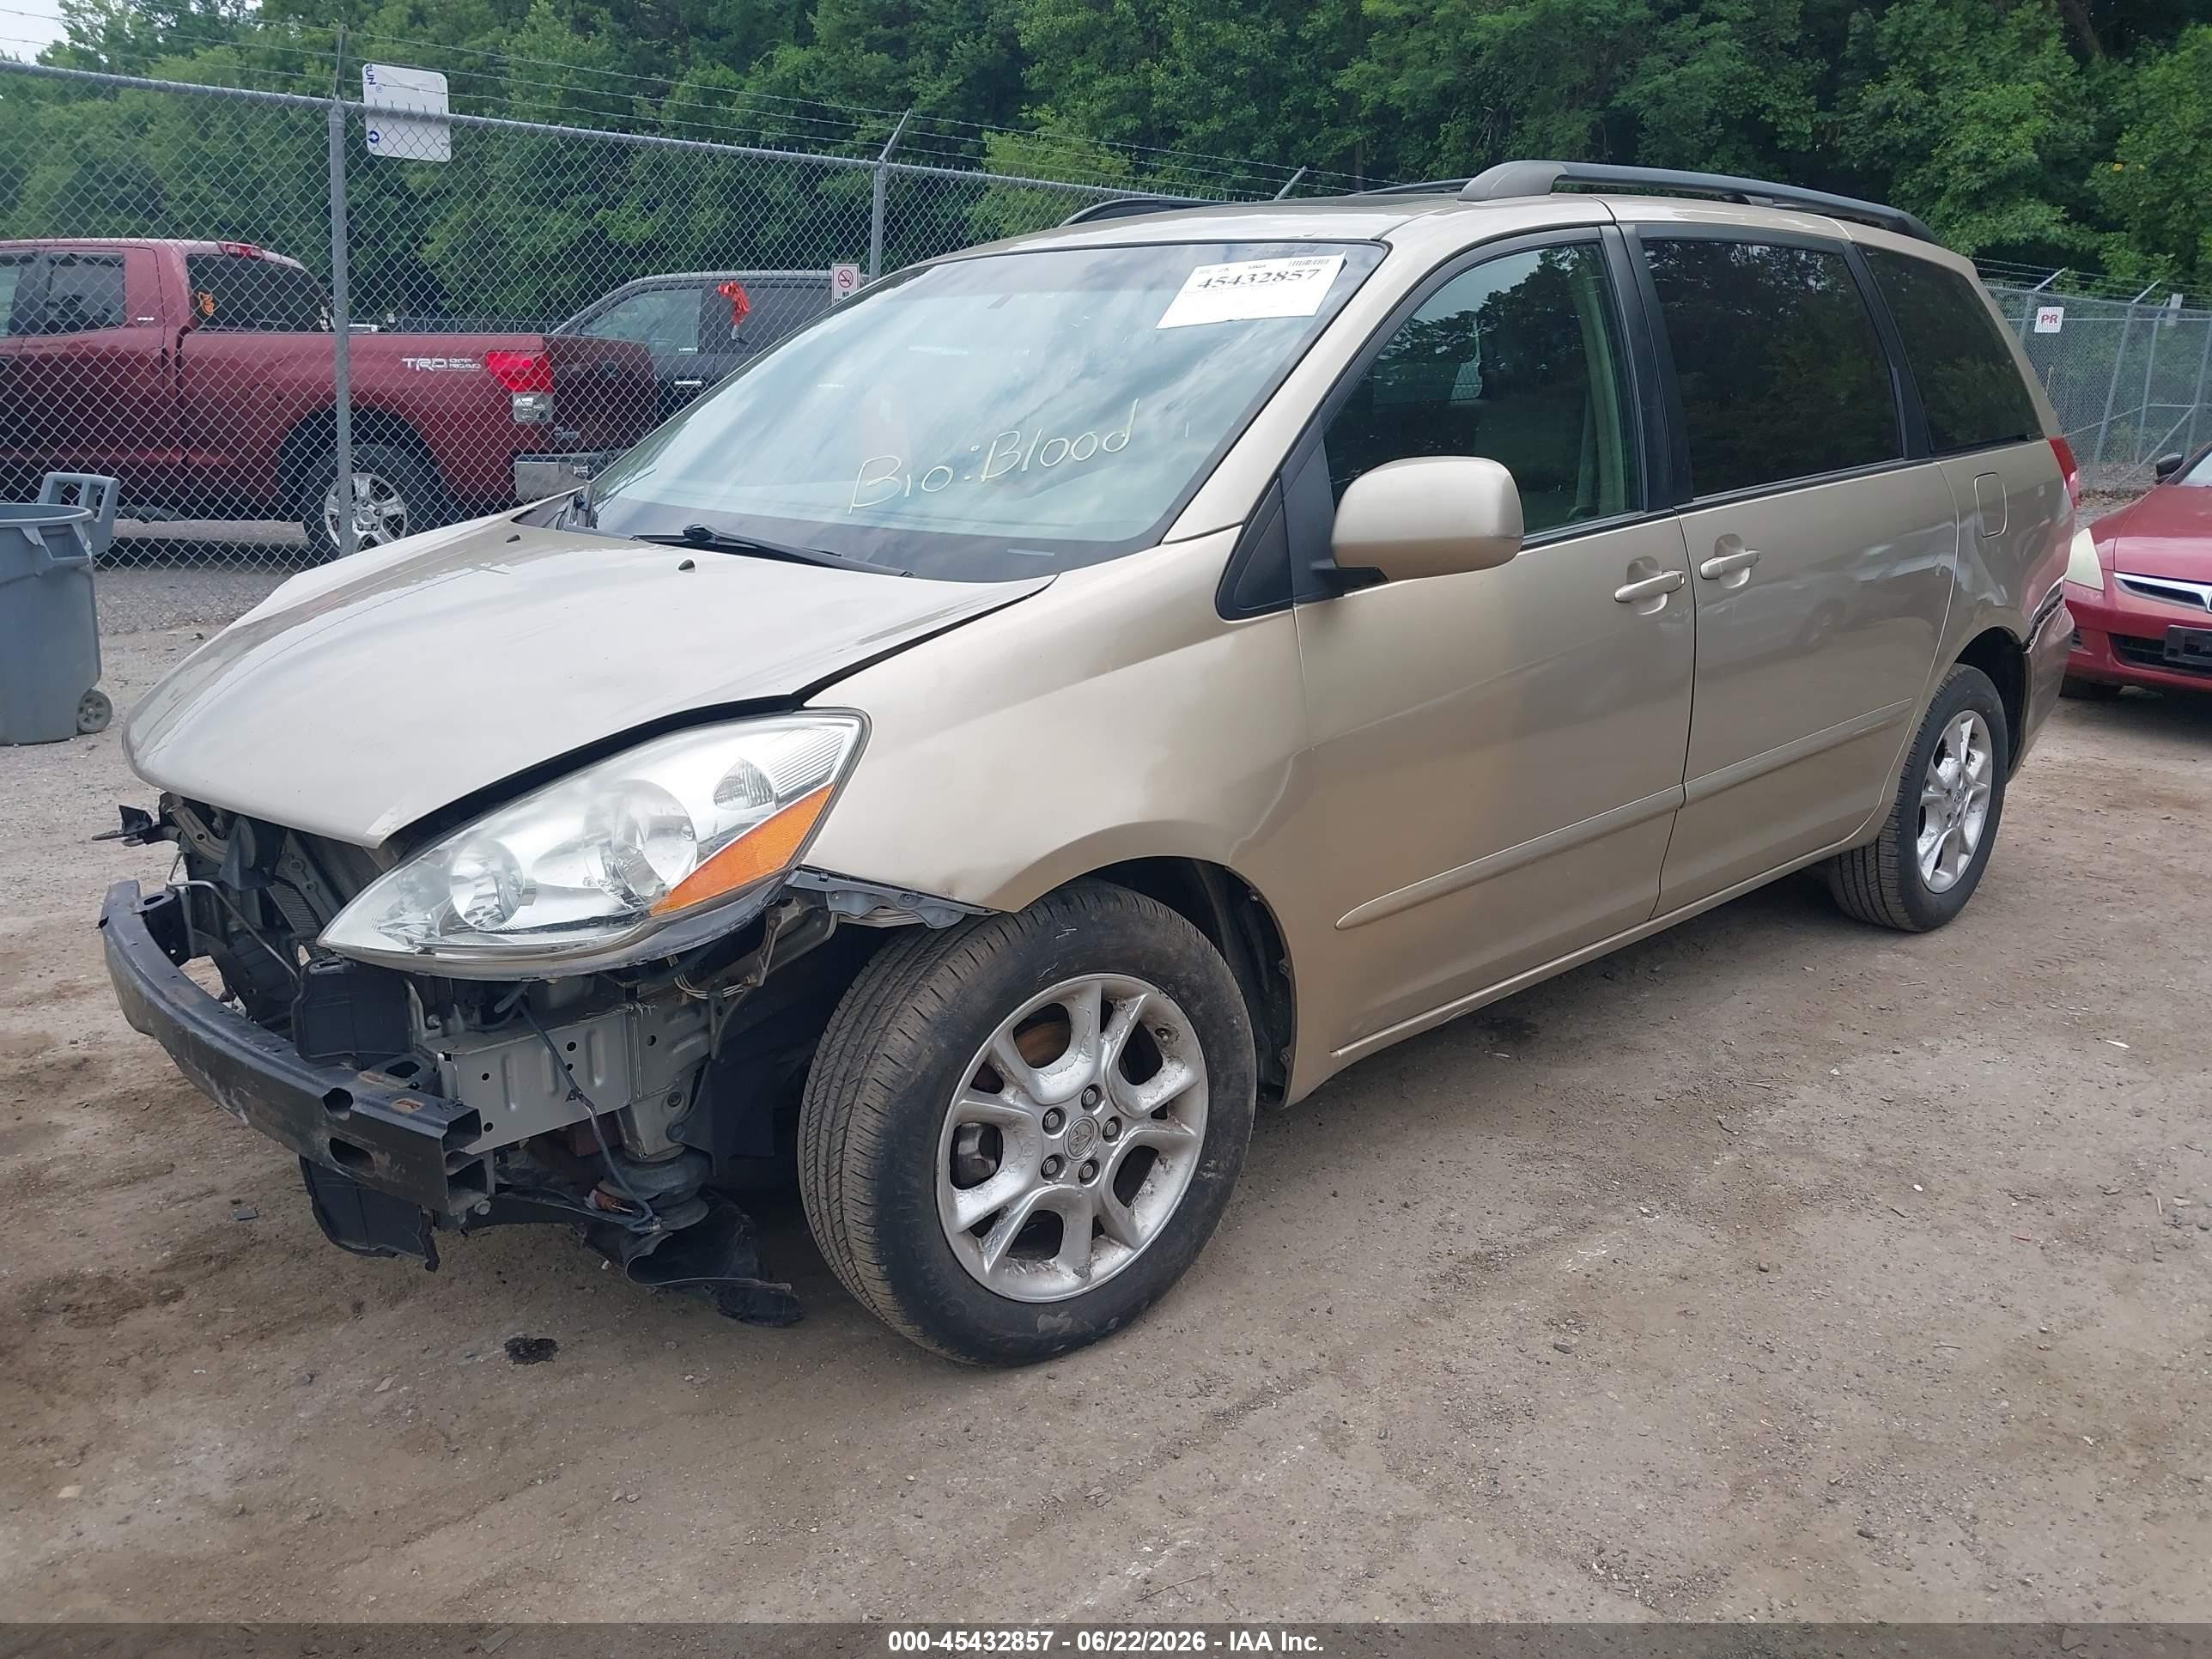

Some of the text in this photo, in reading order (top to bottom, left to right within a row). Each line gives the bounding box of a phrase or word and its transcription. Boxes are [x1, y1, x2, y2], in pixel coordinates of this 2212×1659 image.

[1197, 268, 1322, 289] 45432857
[2040, 314, 2058, 324] PR
[402, 357, 447, 372] TRD
